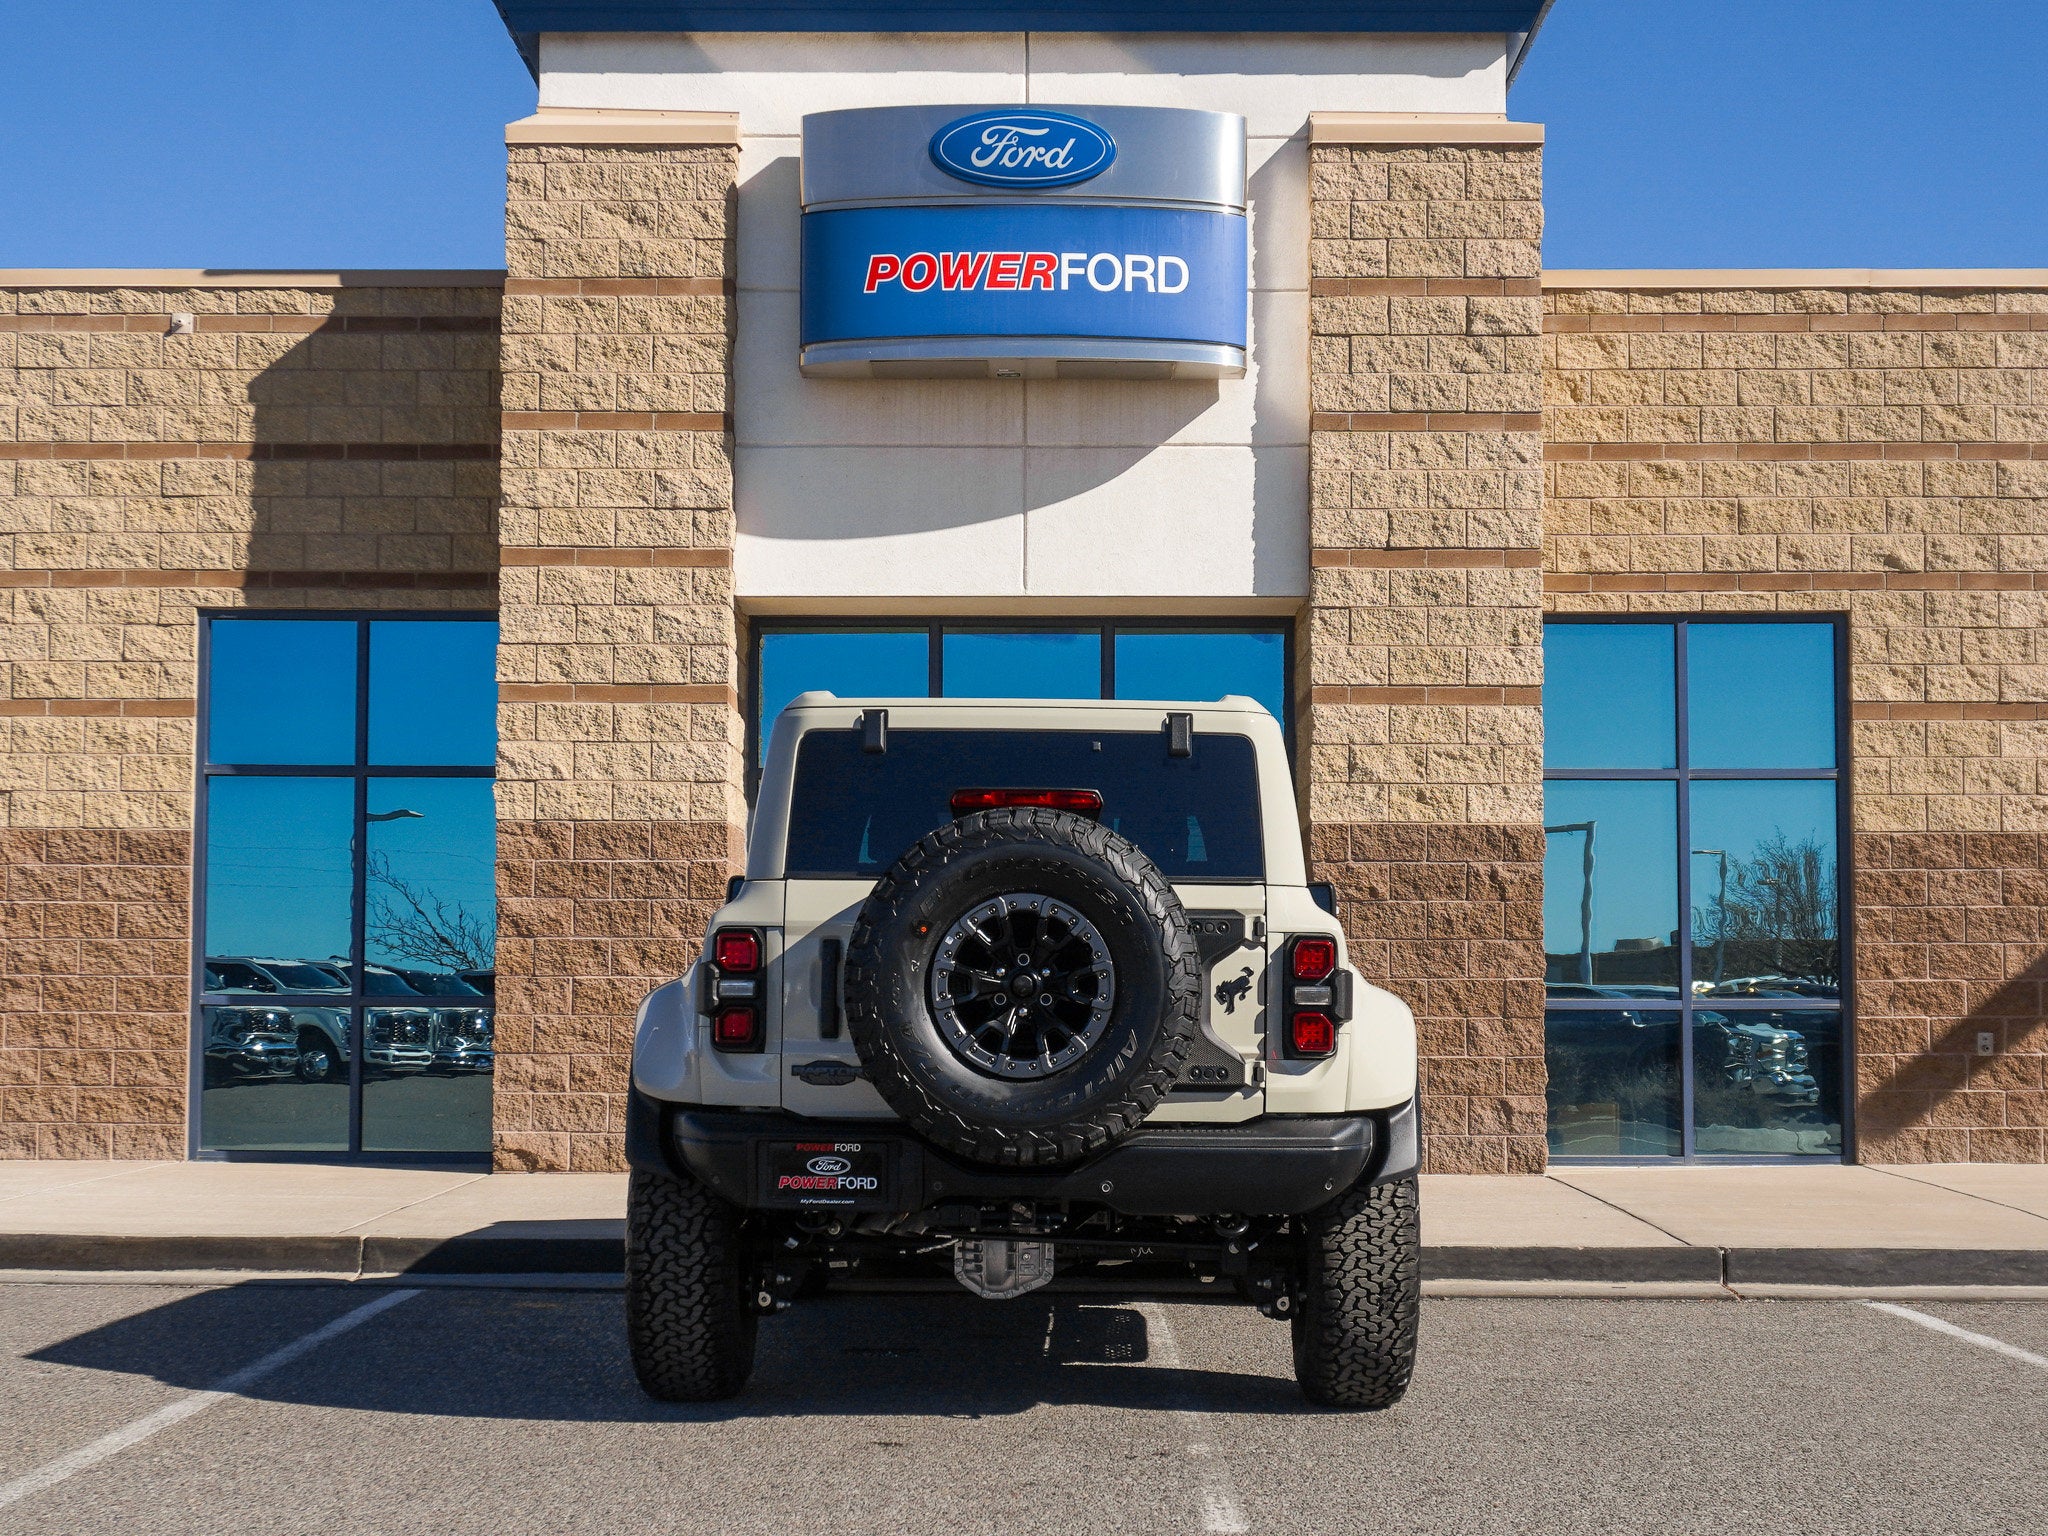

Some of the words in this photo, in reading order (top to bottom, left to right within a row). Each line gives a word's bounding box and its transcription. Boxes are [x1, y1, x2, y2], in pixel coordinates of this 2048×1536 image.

[970, 125, 1076, 170] Ford
[863, 251, 1190, 293] POWERFORD
[796, 1143, 861, 1151] POWERFORD
[815, 1160, 842, 1171] Ford
[778, 1176, 877, 1189] POWERFORD
